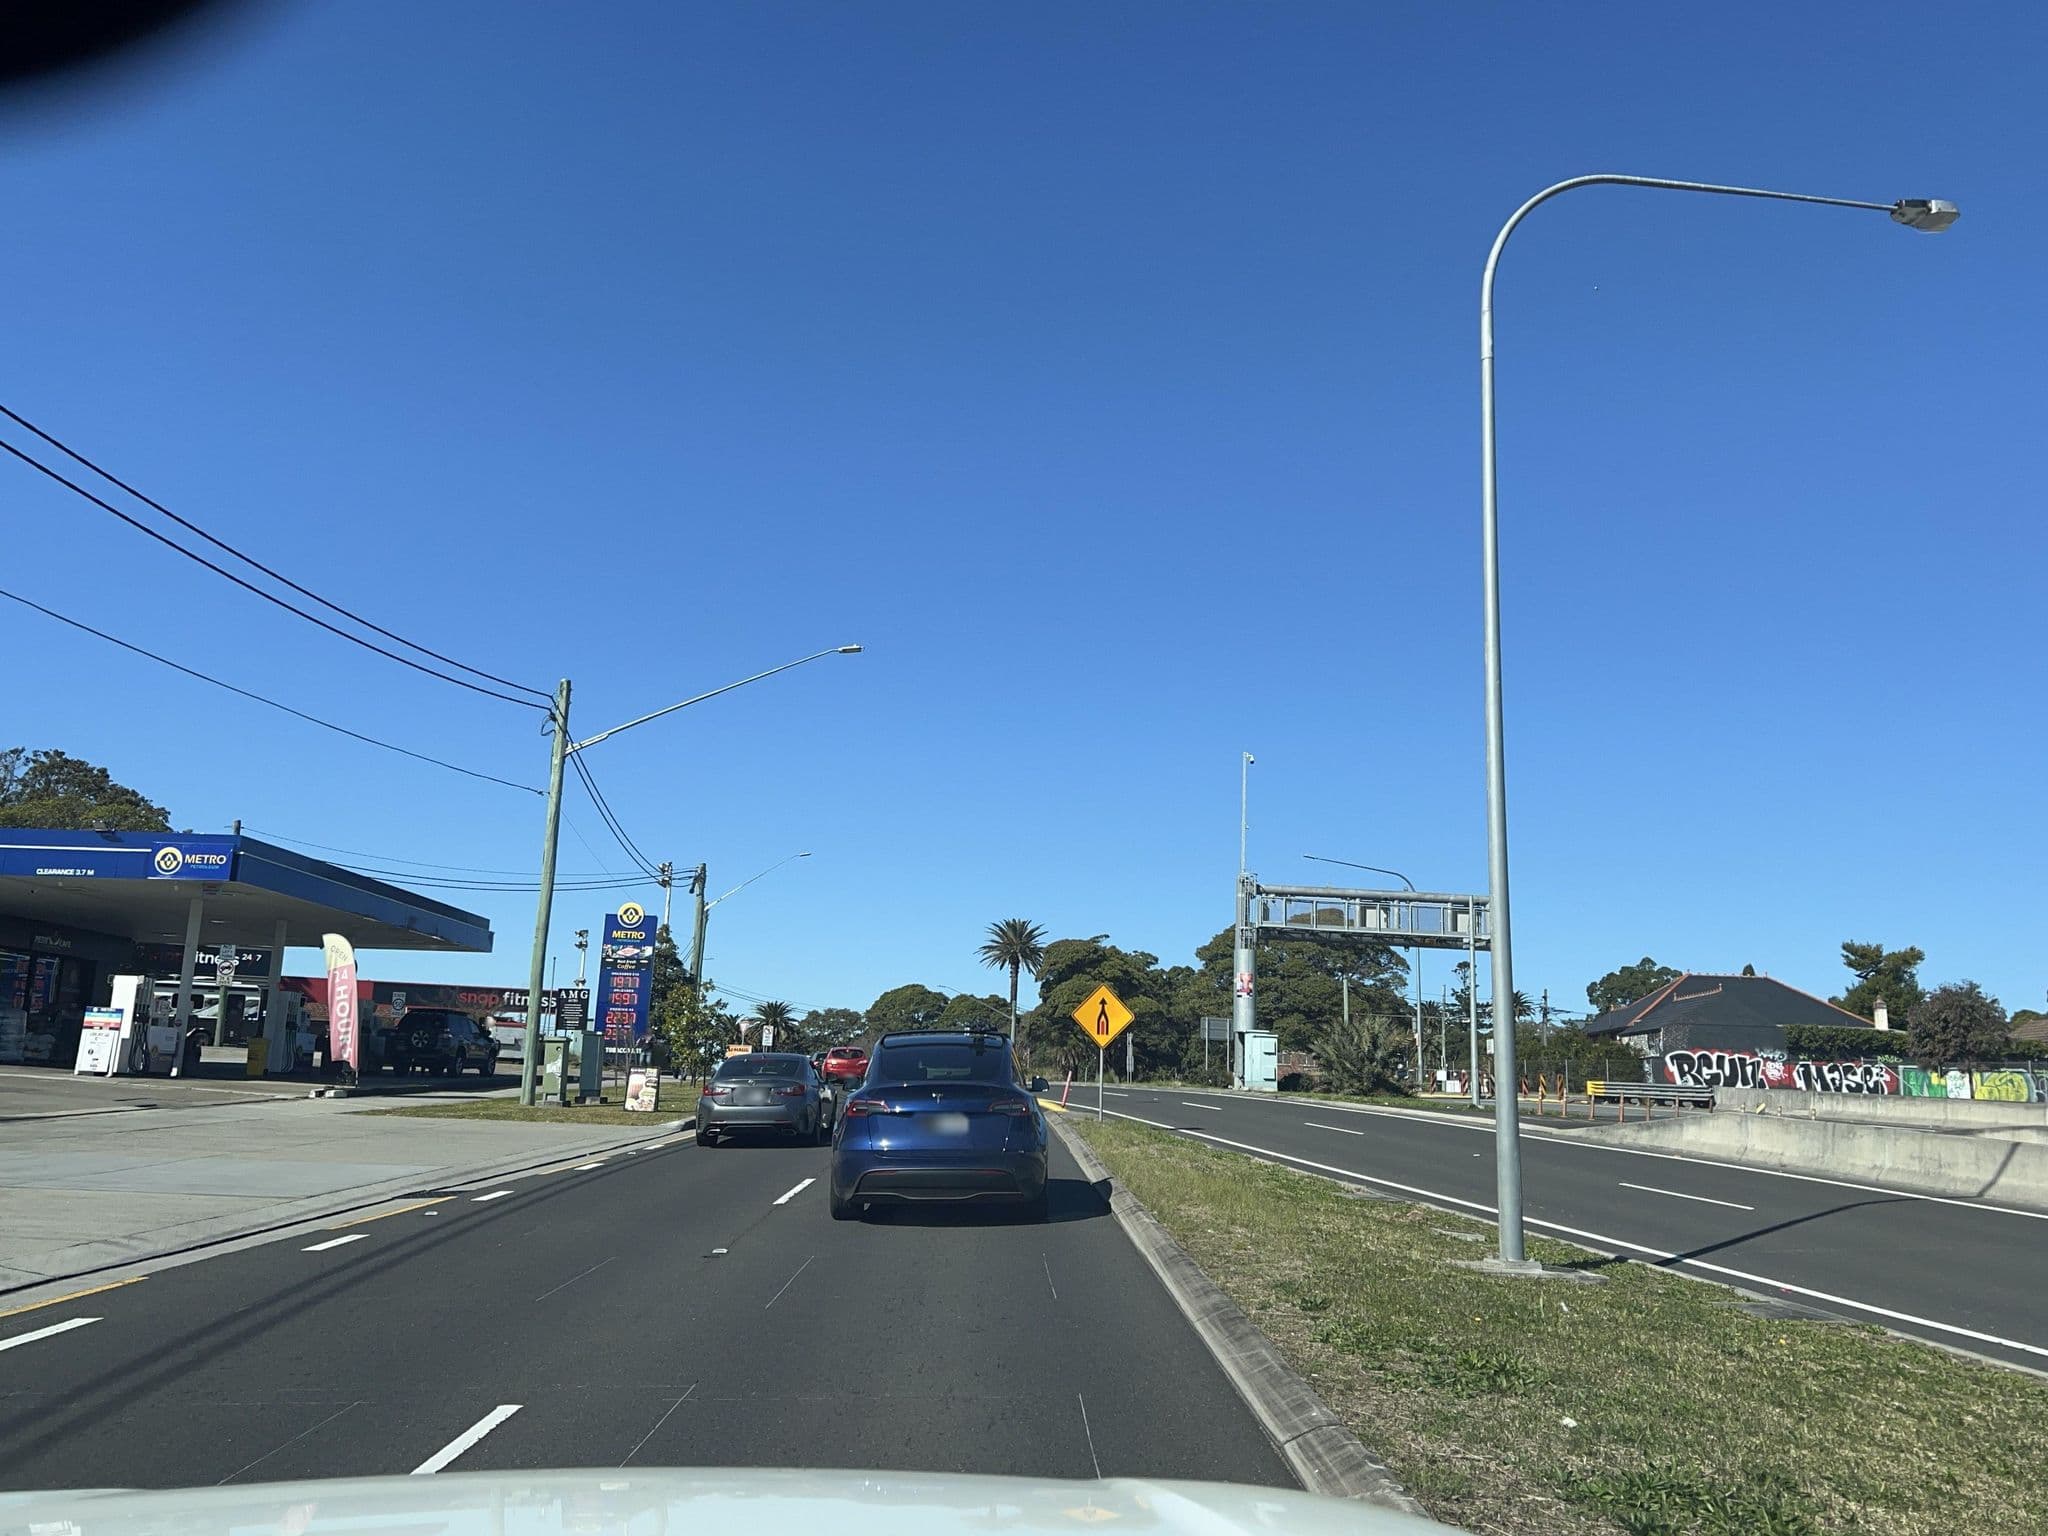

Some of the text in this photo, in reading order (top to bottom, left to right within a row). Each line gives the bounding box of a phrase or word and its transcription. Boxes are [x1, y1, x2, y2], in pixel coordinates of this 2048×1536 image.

[184, 854, 227, 865] METRO
[36, 868, 74, 876] CLEARANCE
[611, 930, 646, 940] METRO
[195, 950, 240, 966] itnes
[330, 945, 348, 962] OPEN
[333, 969, 349, 983] 24
[459, 992, 557, 1008] snap fitnss
[559, 990, 589, 999] AMG
